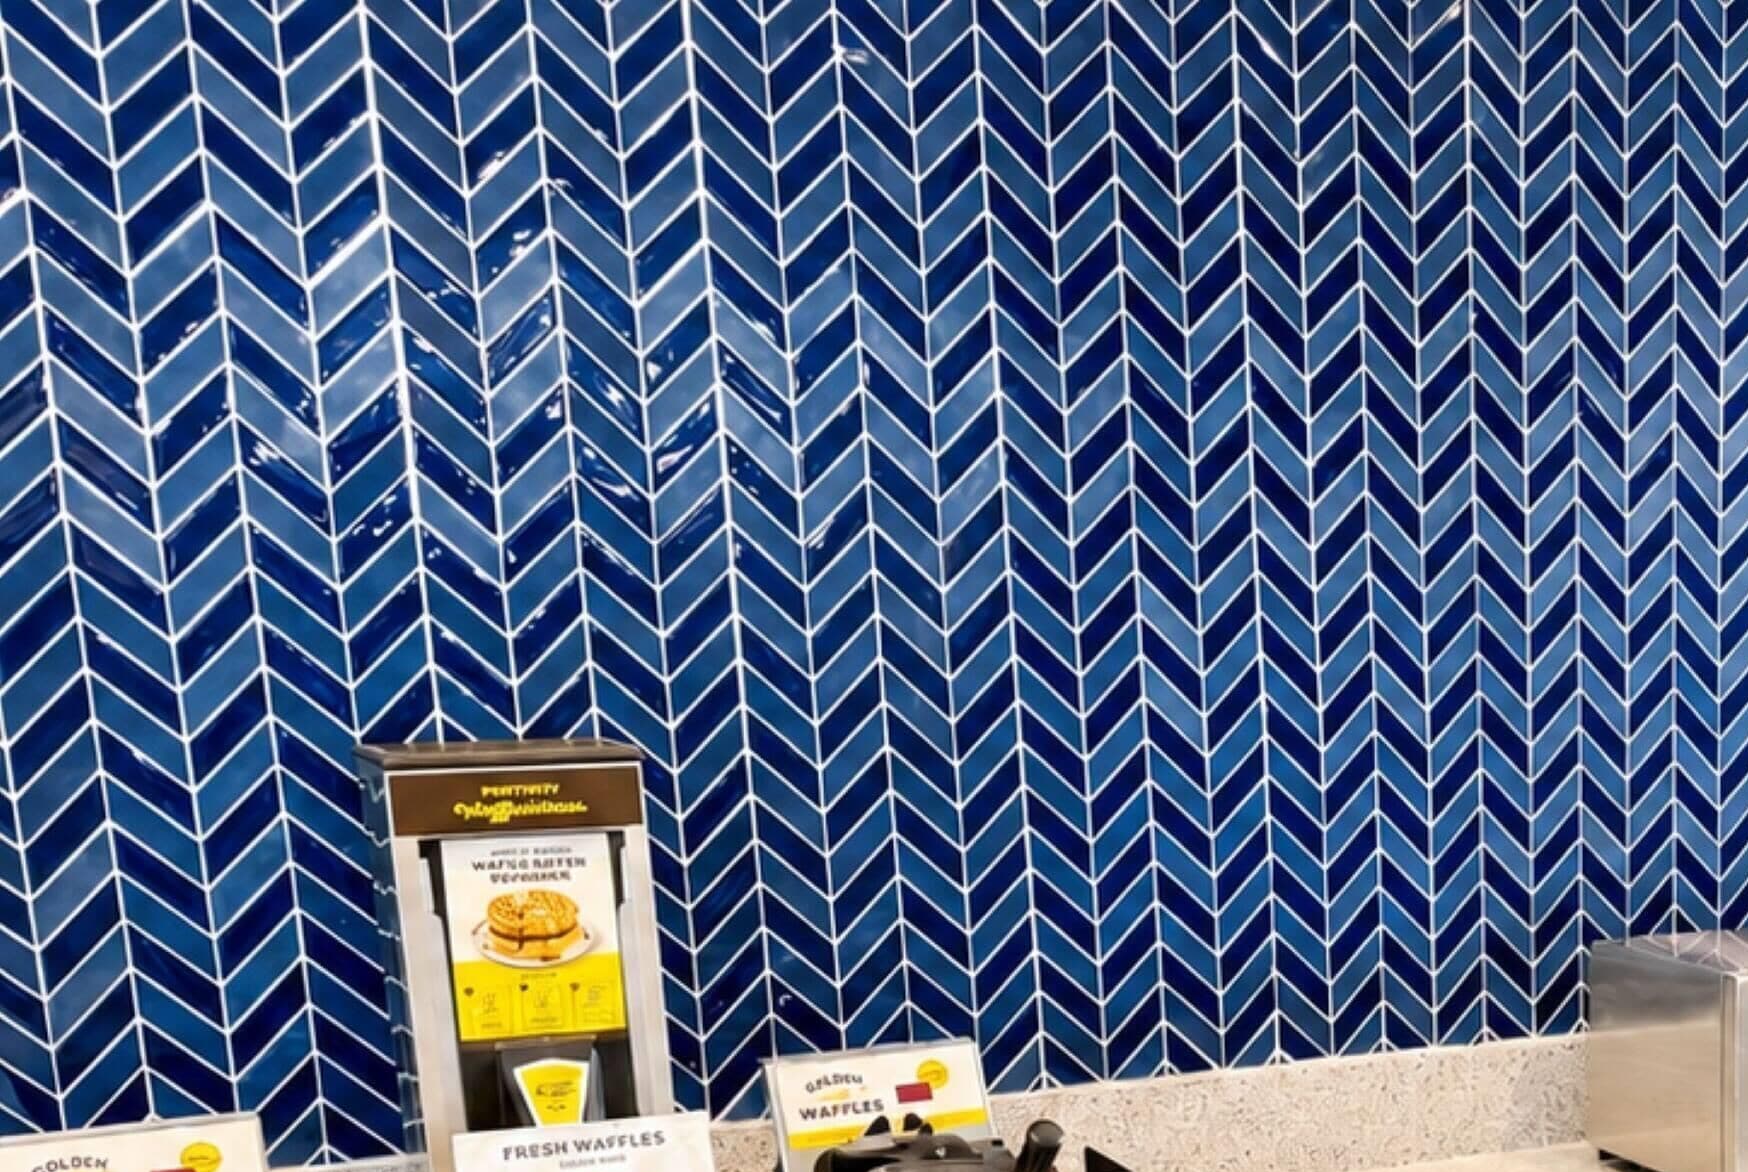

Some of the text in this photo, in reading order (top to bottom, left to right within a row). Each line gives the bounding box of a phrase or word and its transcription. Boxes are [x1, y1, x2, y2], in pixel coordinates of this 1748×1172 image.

[799, 1099, 885, 1121] WAFFLES
[503, 1141, 569, 1161] FRESH
[573, 1130, 666, 1153] WAFFLES
